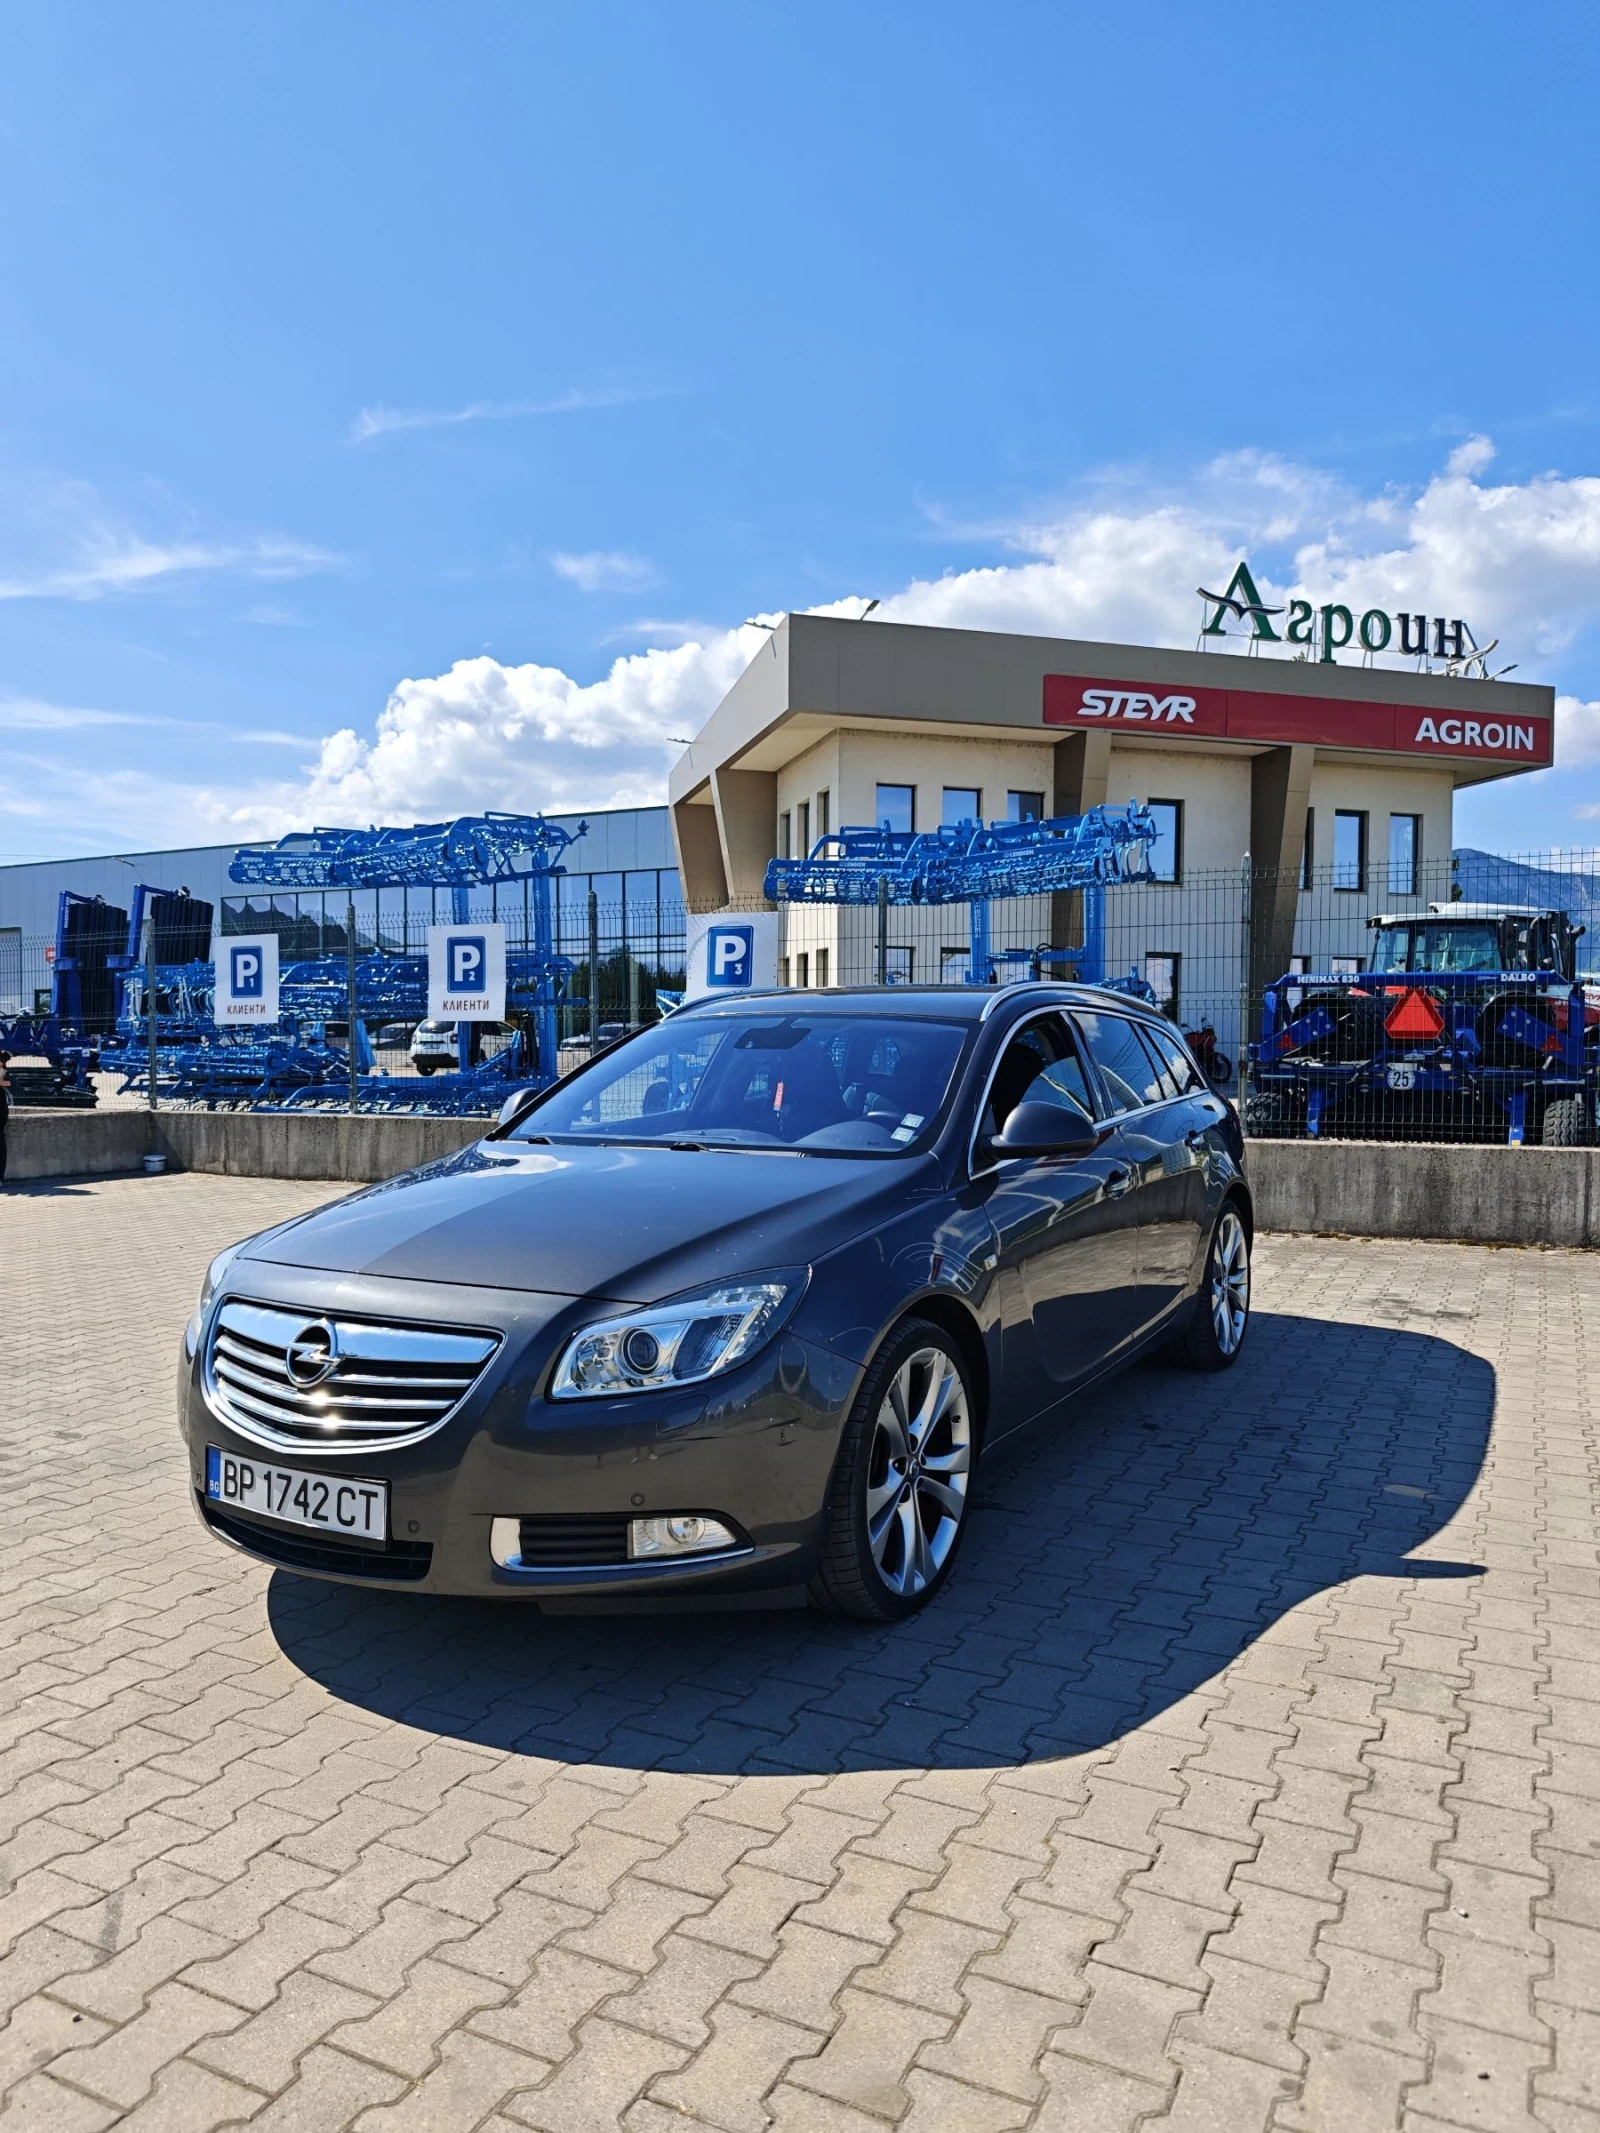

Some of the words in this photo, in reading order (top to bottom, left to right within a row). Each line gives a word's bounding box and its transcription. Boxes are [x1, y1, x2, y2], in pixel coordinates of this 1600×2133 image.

[1197, 562, 1467, 665] Агроин
[1077, 689, 1197, 723] STEYR
[1414, 717, 1534, 751] AGROIN
[1297, 975, 1340, 984] MINIMAX
[1500, 973, 1537, 982] DALBO
[227, 1004, 266, 1015] КЛИЕНТИ
[443, 1000, 490, 1011] КЛИЕНТИ
[1393, 1071, 1409, 1087] 25
[209, 1479, 220, 1493] BG
[263, 1470, 329, 1522] 1742
